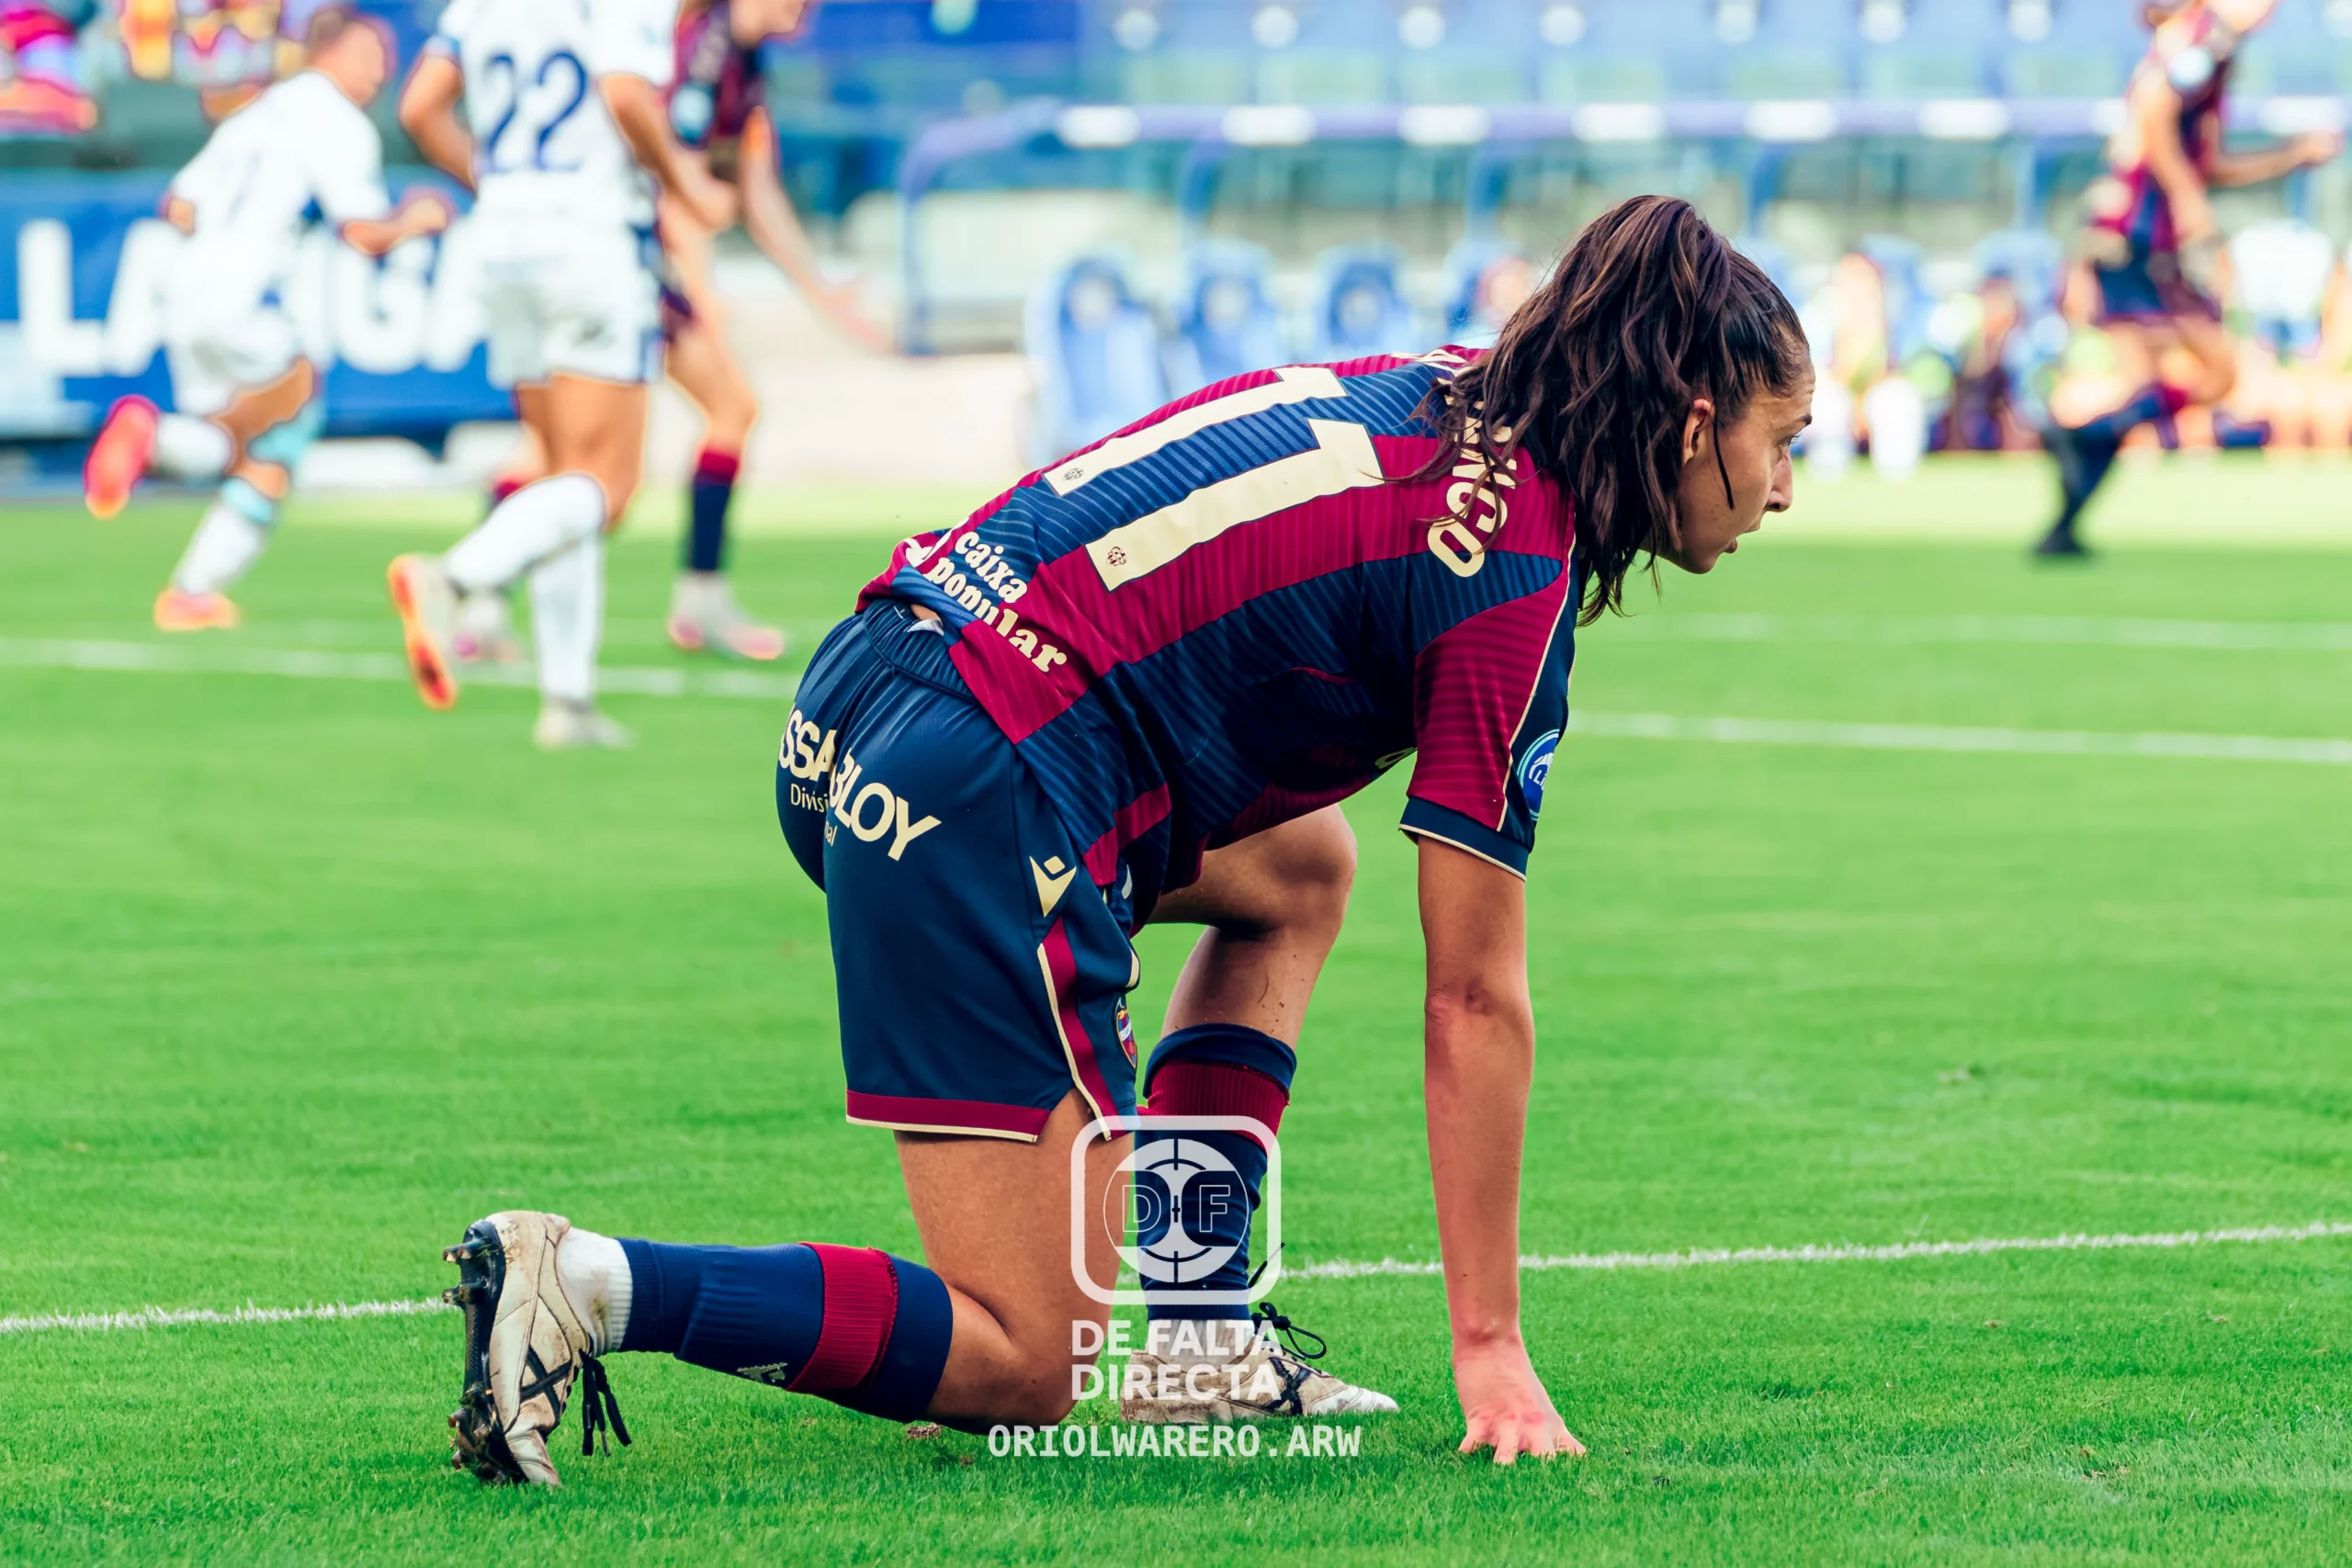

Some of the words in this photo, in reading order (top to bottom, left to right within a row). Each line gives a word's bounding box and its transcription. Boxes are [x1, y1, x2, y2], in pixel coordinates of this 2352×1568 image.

[482, 50, 589, 173] 22
[1042, 366, 1385, 592] 11
[955, 531, 1028, 604] caixa
[779, 705, 838, 782] SSA
[829, 747, 943, 862] BLOY
